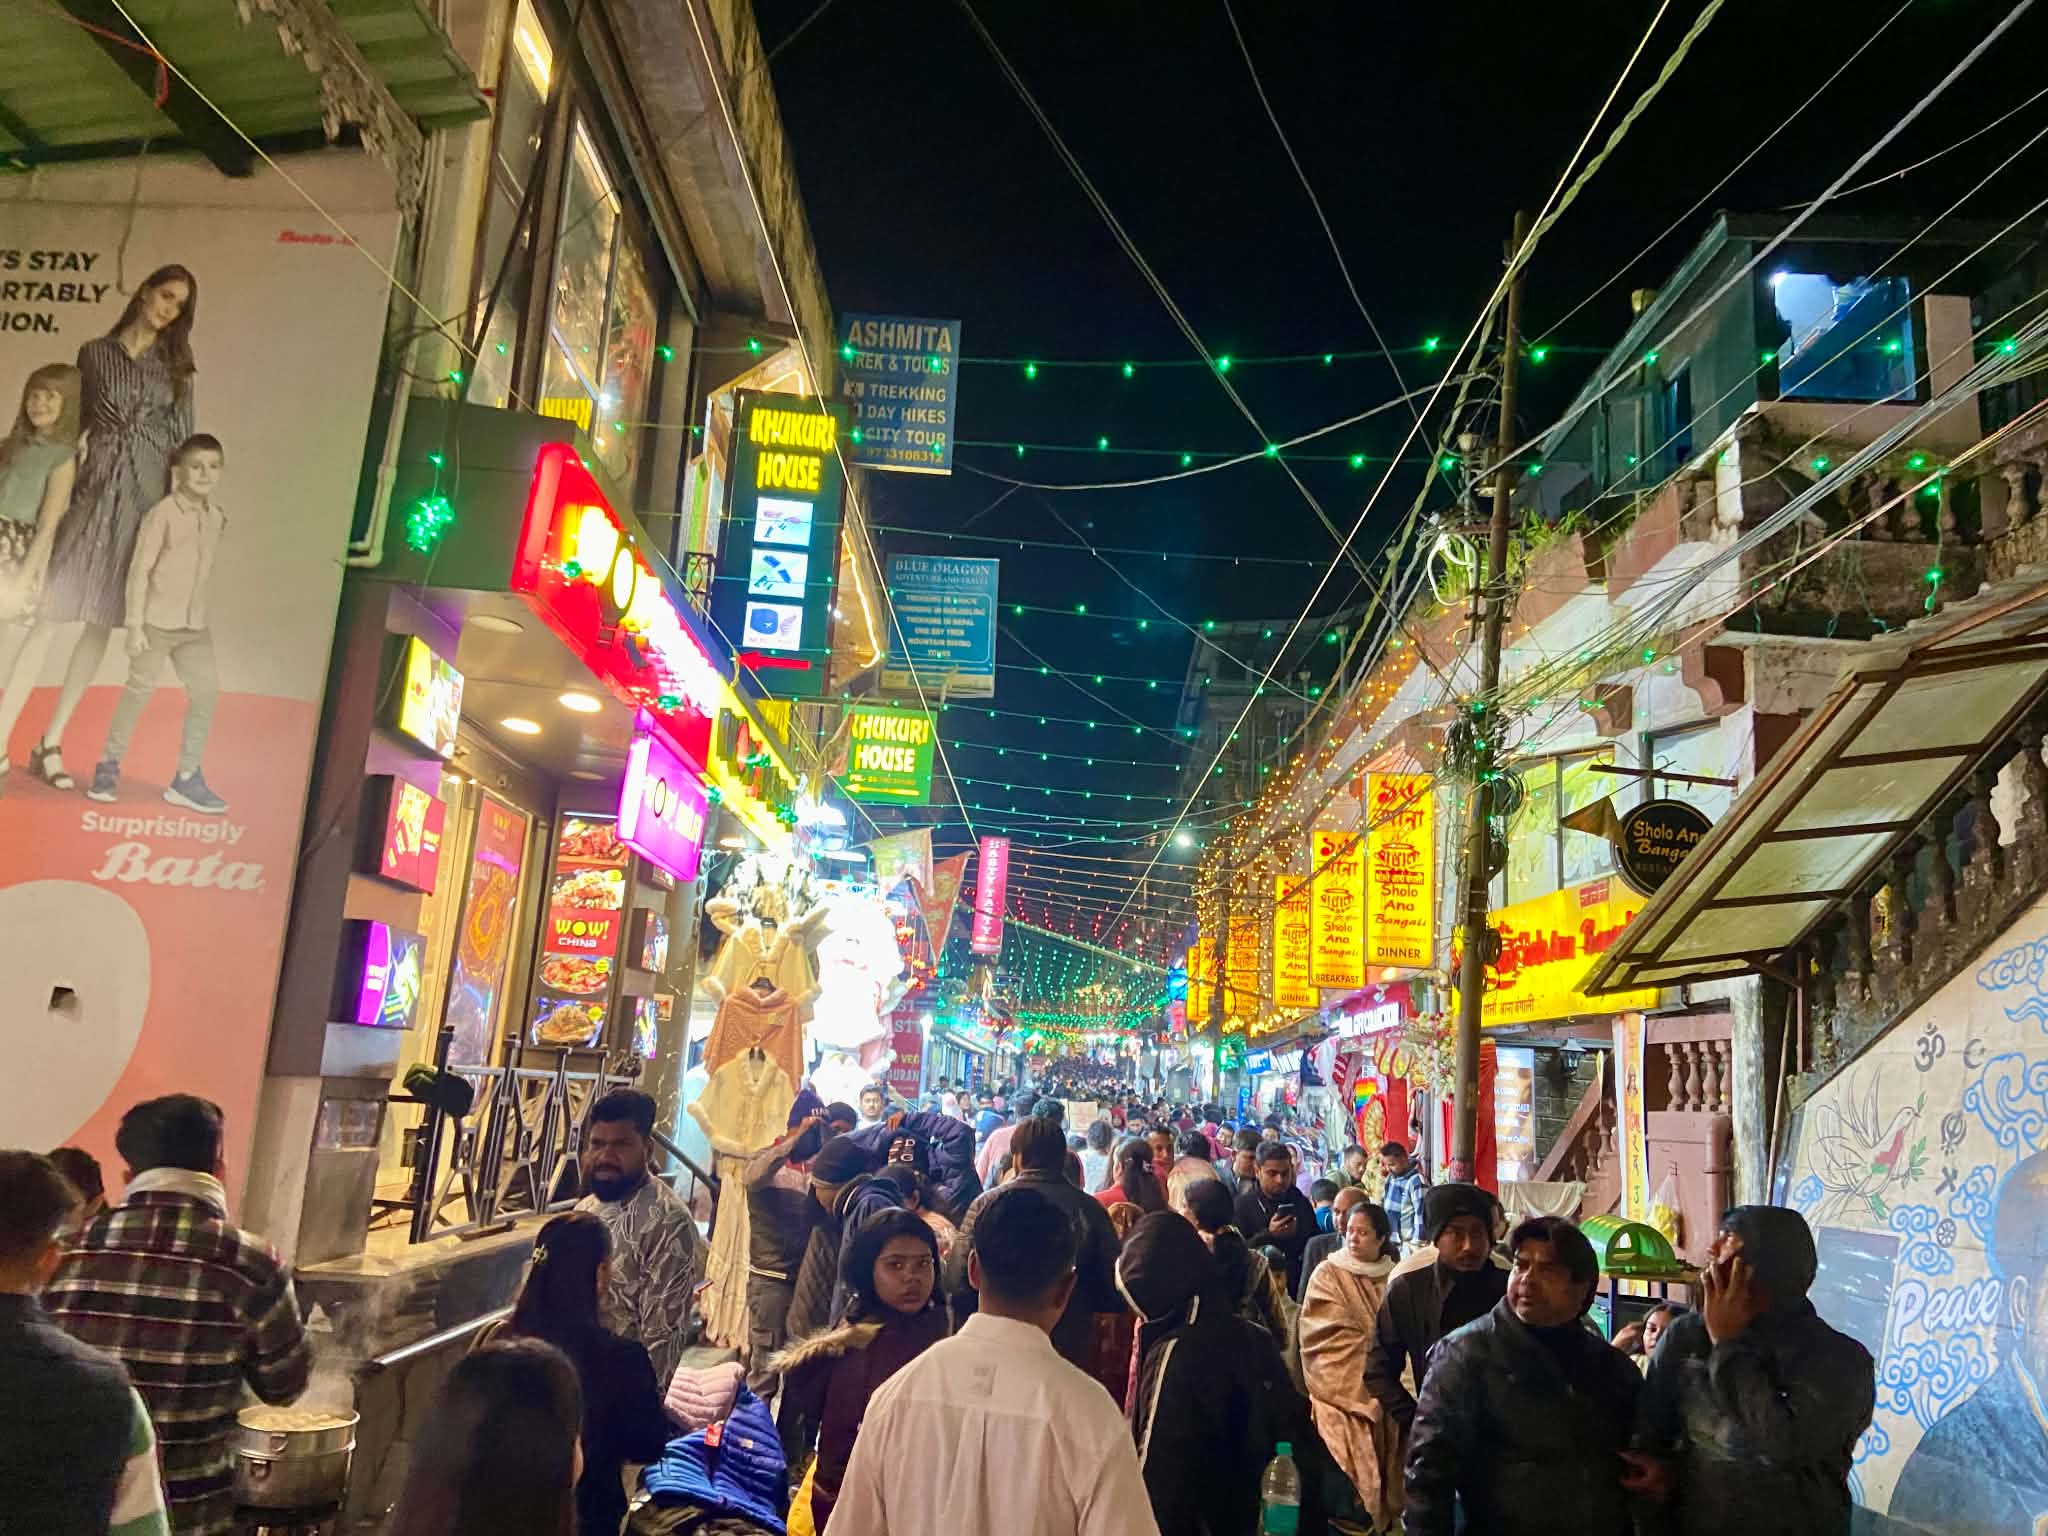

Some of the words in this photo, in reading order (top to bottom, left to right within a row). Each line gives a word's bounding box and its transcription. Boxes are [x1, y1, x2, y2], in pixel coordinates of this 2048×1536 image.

[28, 250, 100, 272] STAY
[848, 320, 952, 352] ASHMITA
[889, 354, 897, 371] &
[903, 354, 950, 376] TOUS
[869, 383, 946, 402] TREKKING
[868, 405, 896, 420] DAY
[902, 407, 946, 425] HIKES
[750, 408, 837, 452] KHUKURI
[865, 426, 901, 442] CITY
[906, 429, 946, 447] TOUR
[757, 452, 820, 491] HOUSE
[896, 560, 928, 572] BLUE
[934, 562, 989, 575] DRAGON
[854, 744, 916, 773] HOUSE
[80, 810, 247, 845] Surprisingly
[1633, 820, 1674, 841] Sholo
[91, 841, 266, 892] Bata
[1381, 883, 1418, 898] Sholo
[1384, 899, 1415, 912] Ana
[556, 919, 609, 940] WOW!
[1377, 947, 1420, 959] DINNER
[1315, 973, 1360, 984] BREAKFAST
[1892, 1277, 2001, 1350] Peace
